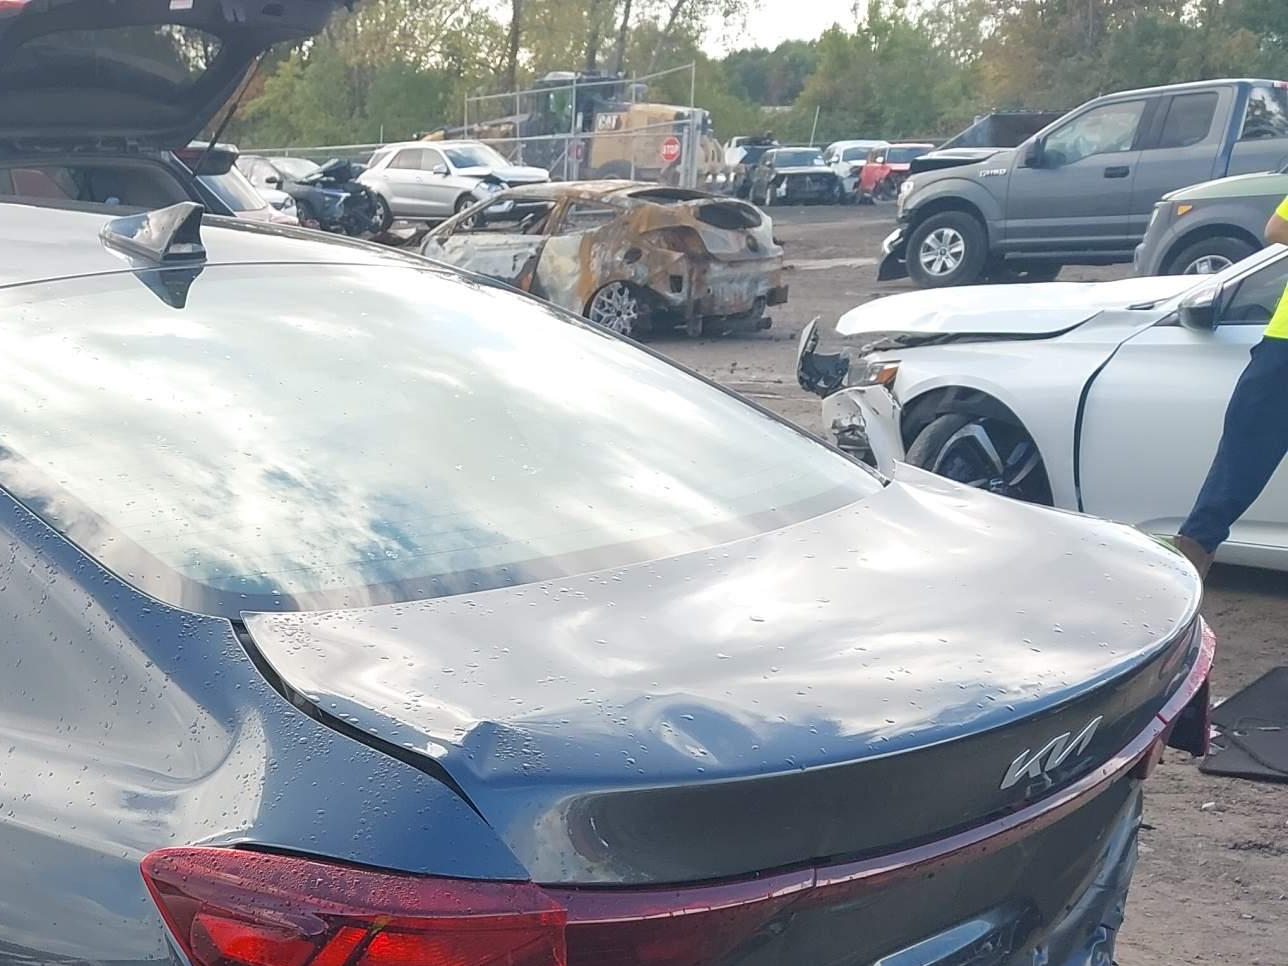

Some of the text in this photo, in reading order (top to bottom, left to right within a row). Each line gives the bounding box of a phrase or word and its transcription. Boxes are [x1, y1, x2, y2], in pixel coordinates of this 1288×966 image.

[598, 115, 618, 130] CAT
[662, 144, 680, 155] STOP
[999, 715, 1104, 790] KIA
